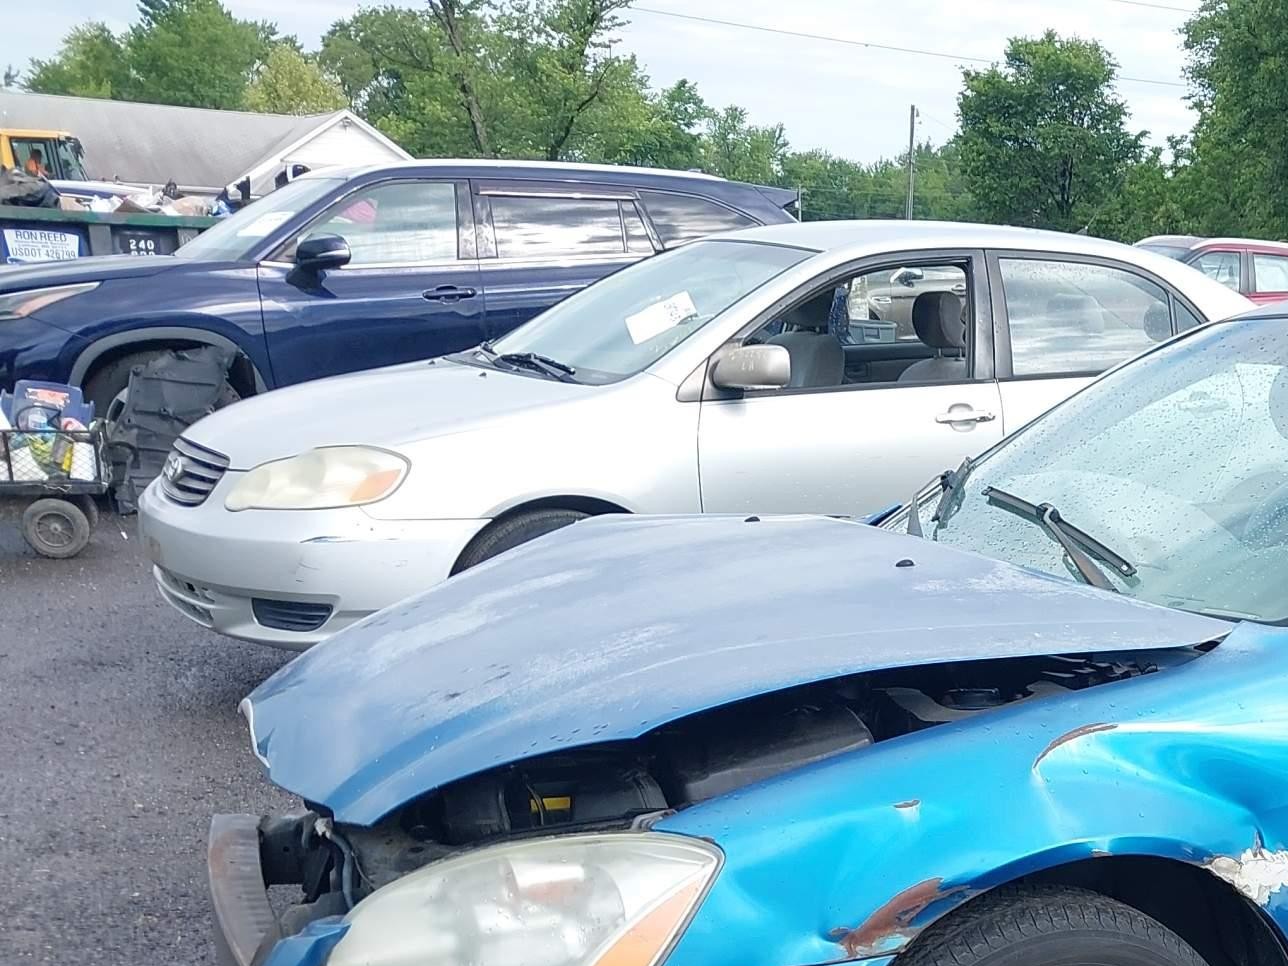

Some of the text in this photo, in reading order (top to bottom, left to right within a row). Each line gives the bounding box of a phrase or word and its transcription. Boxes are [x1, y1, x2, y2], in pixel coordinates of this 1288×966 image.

[15, 230, 67, 242] RON REED
[129, 239, 155, 250] 240
[11, 247, 42, 257] USDOT
